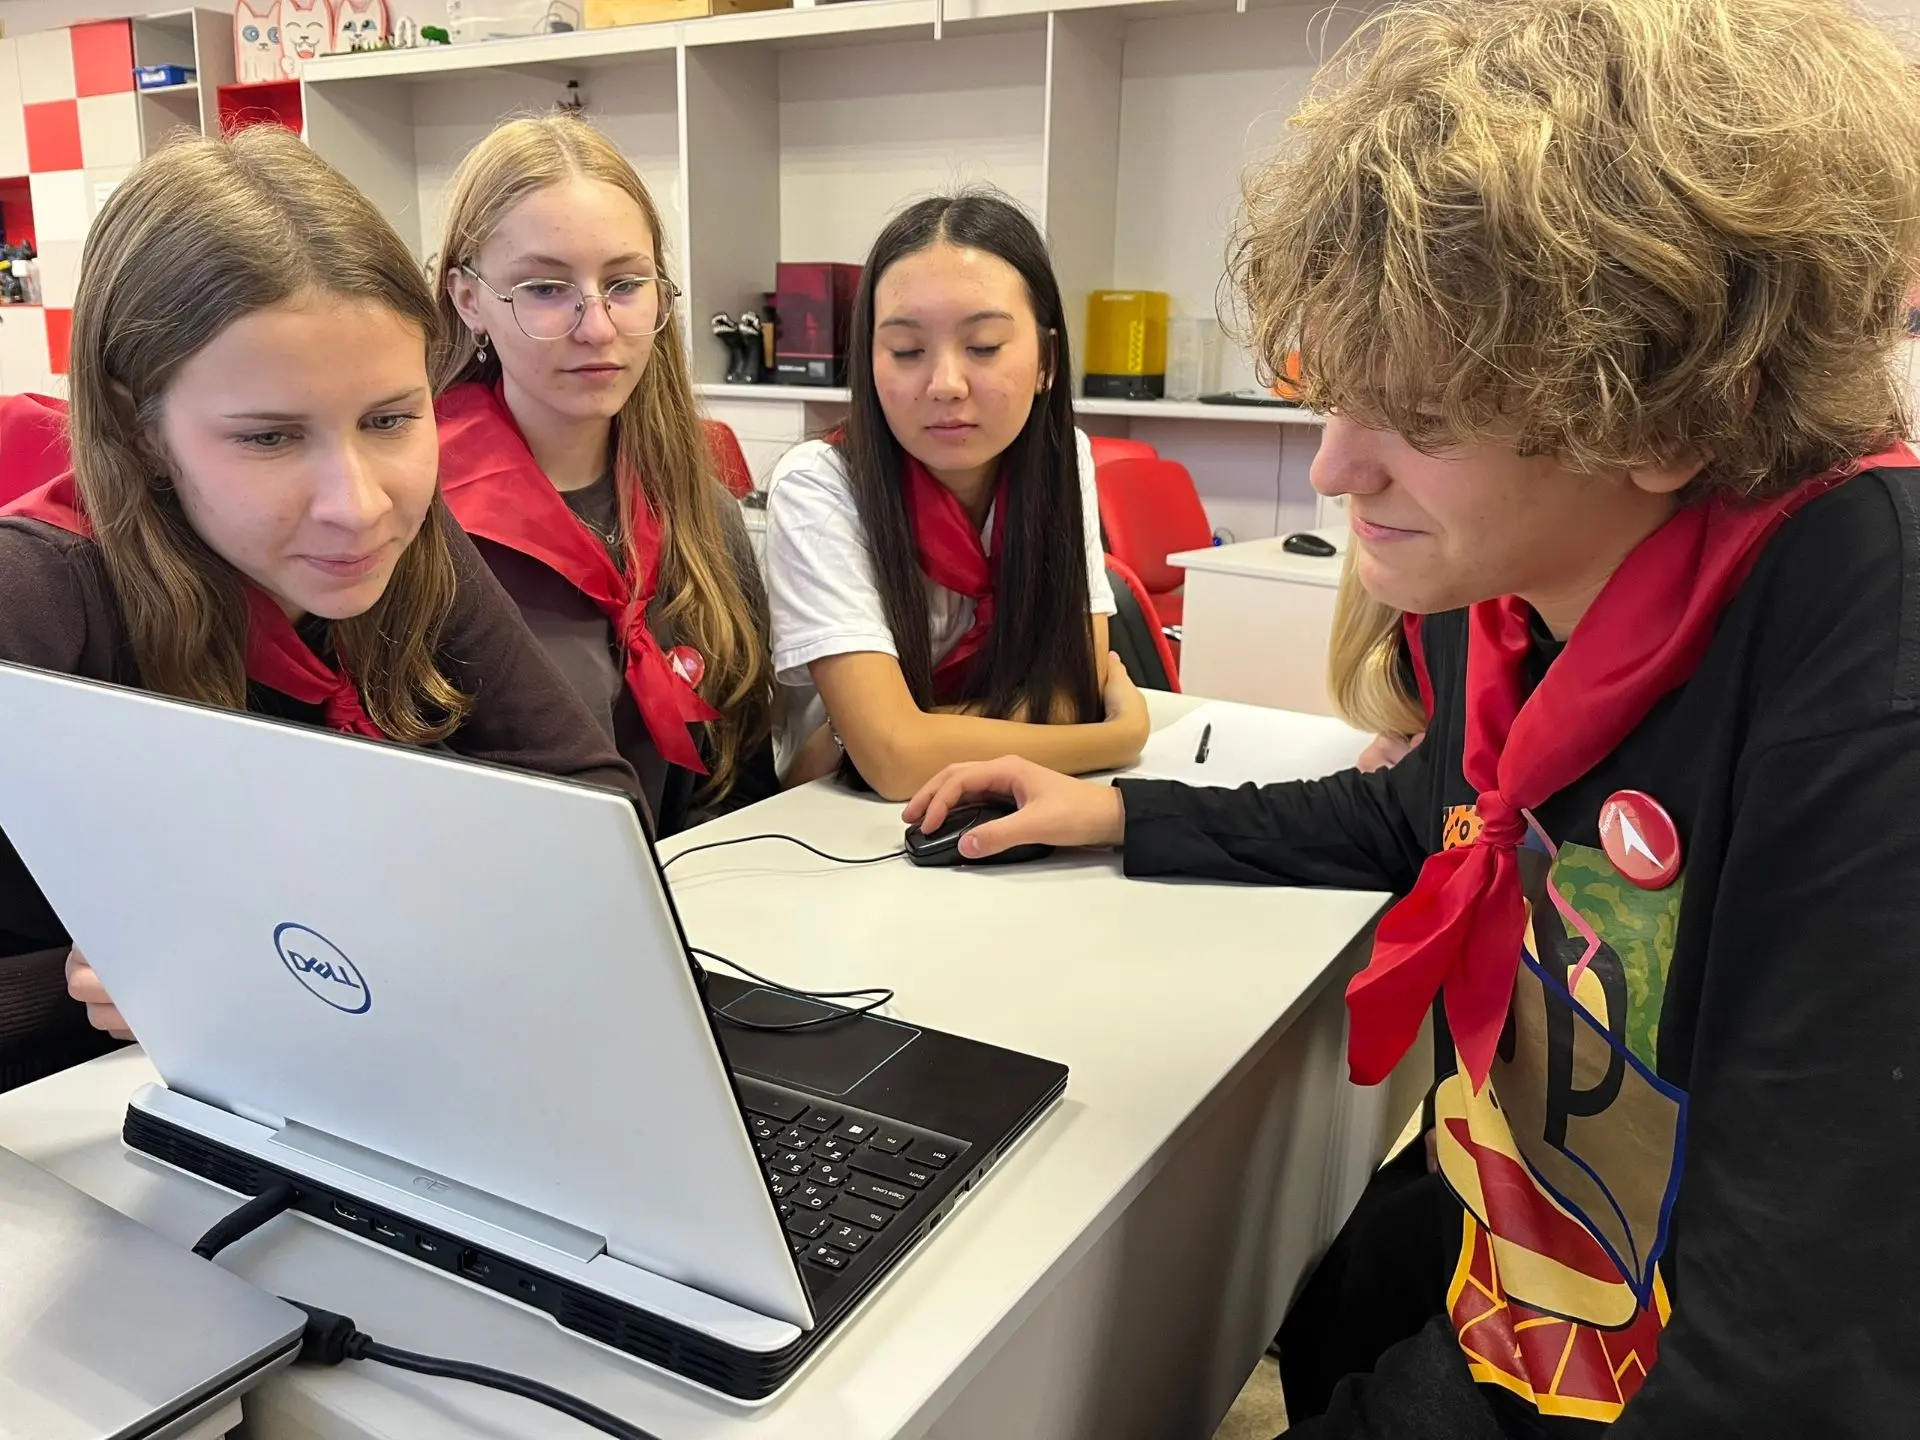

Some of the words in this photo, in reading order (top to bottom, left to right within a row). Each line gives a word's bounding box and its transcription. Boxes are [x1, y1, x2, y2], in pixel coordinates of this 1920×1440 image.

[287, 949, 361, 989] DELL
[932, 1151, 947, 1159] Ctrl
[908, 1171, 926, 1180] Shift
[872, 1185, 889, 1195] Lock
[888, 1191, 906, 1200] Caps
[870, 1213, 882, 1222] Tab
[825, 1256, 840, 1266] Esc
